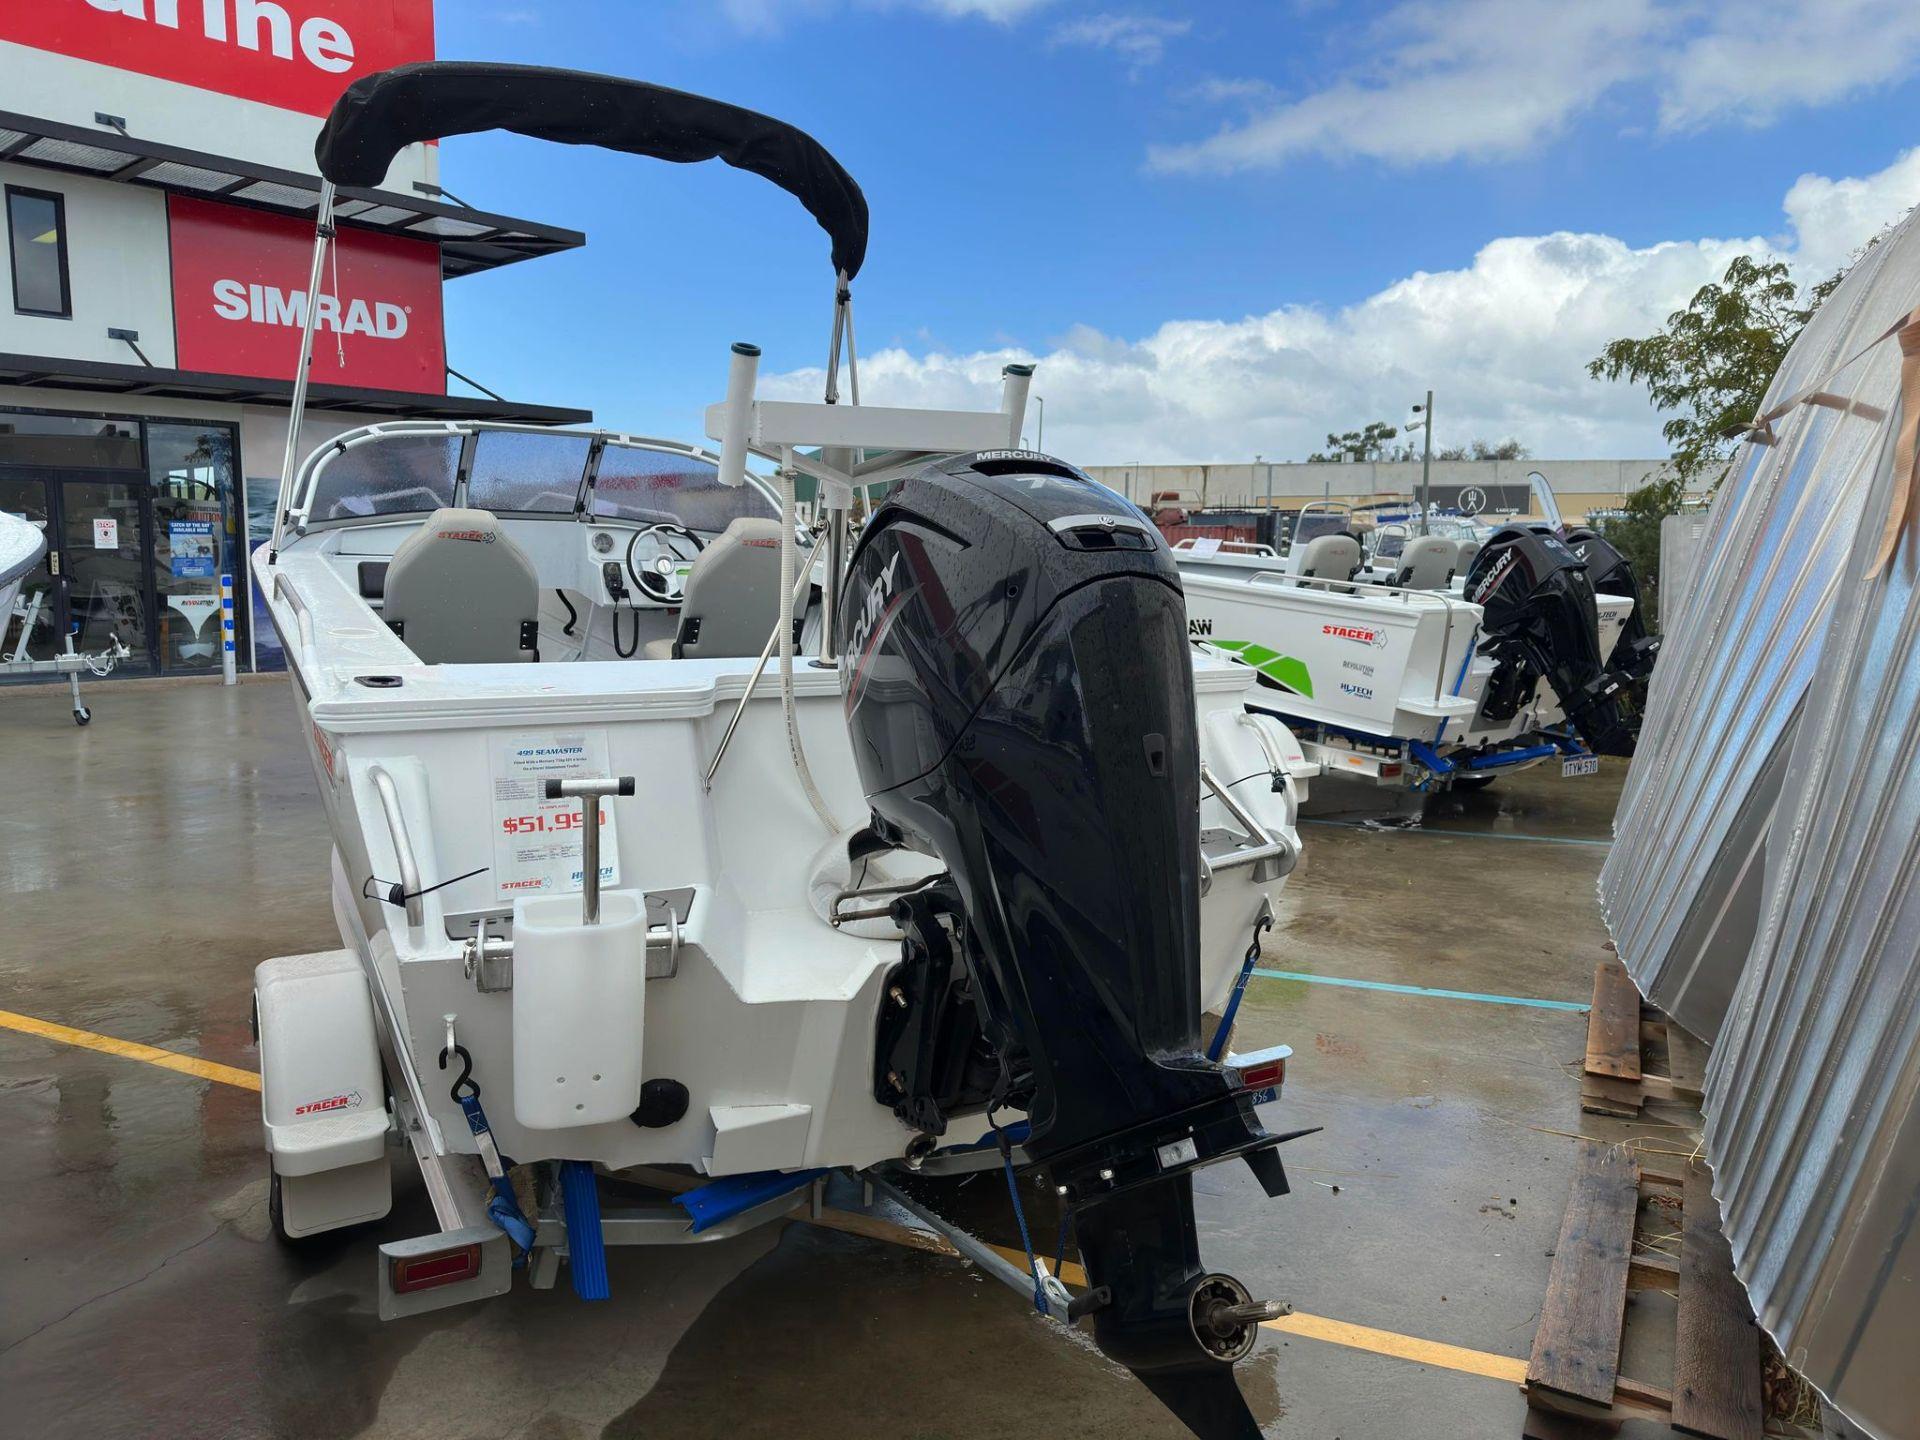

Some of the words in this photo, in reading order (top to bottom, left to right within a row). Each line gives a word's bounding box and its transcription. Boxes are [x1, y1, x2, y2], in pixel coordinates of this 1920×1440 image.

[976, 451, 1051, 462] MERCURY
[1189, 619, 1212, 635] AW
[1322, 625, 1374, 641] STACER
[1342, 660, 1374, 673] REVOLUTION
[517, 749, 534, 757] 499
[535, 747, 583, 756] SEAMASTER
[501, 879, 542, 890] STACER
[296, 1097, 348, 1115] STACER
